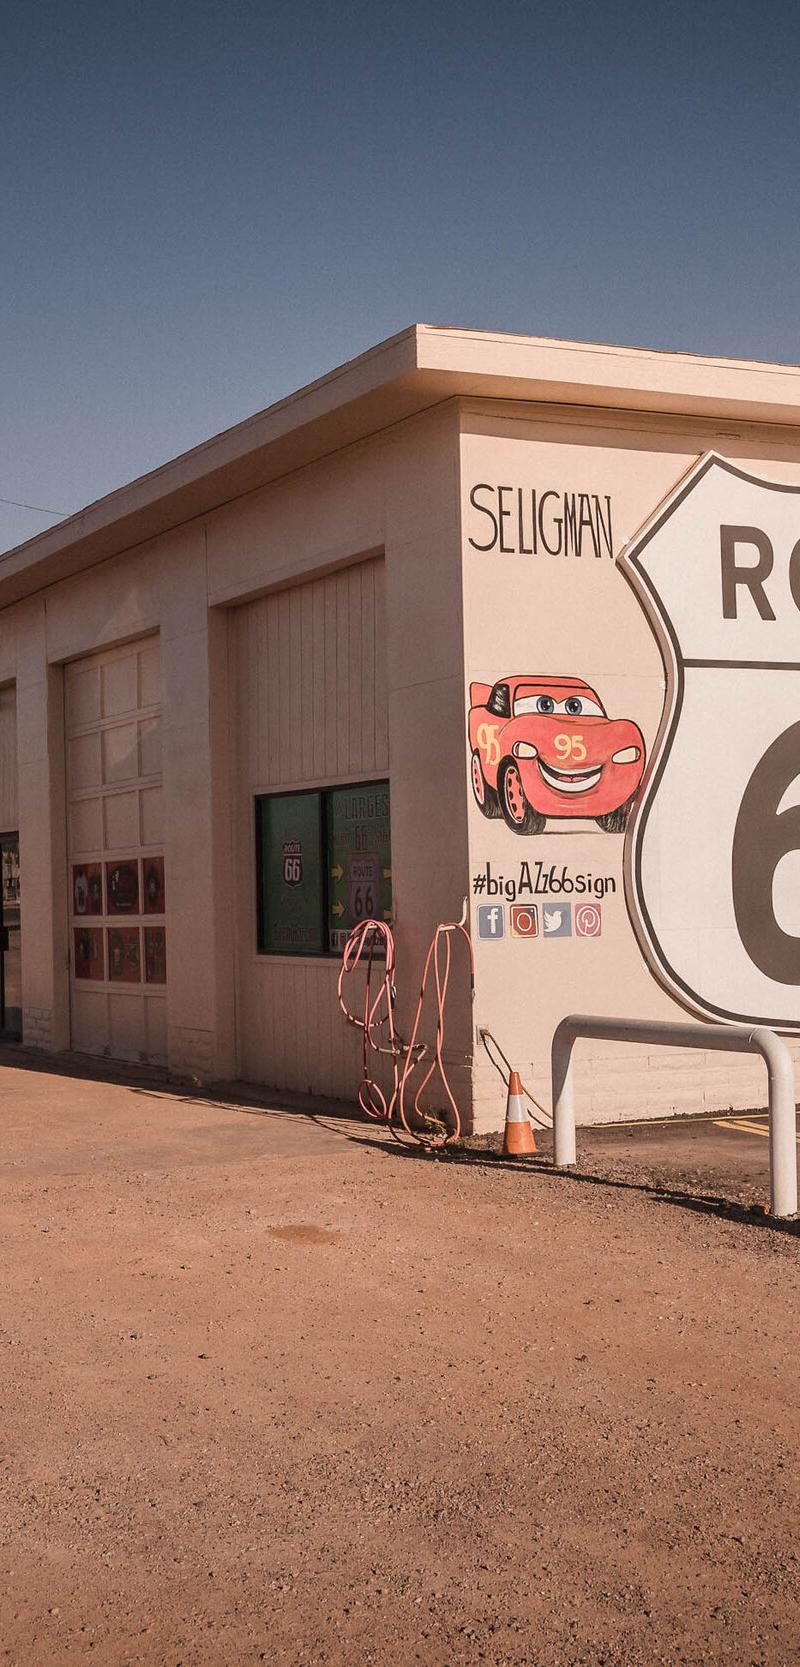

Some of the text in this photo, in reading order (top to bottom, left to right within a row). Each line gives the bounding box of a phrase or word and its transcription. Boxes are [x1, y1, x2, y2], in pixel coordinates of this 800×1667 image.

[468, 484, 613, 558] SELIGMAN
[720, 525, 800, 621] R
[477, 723, 500, 765] 95
[554, 734, 587, 760] 95
[285, 859, 300, 881] 66
[354, 886, 374, 916] 66
